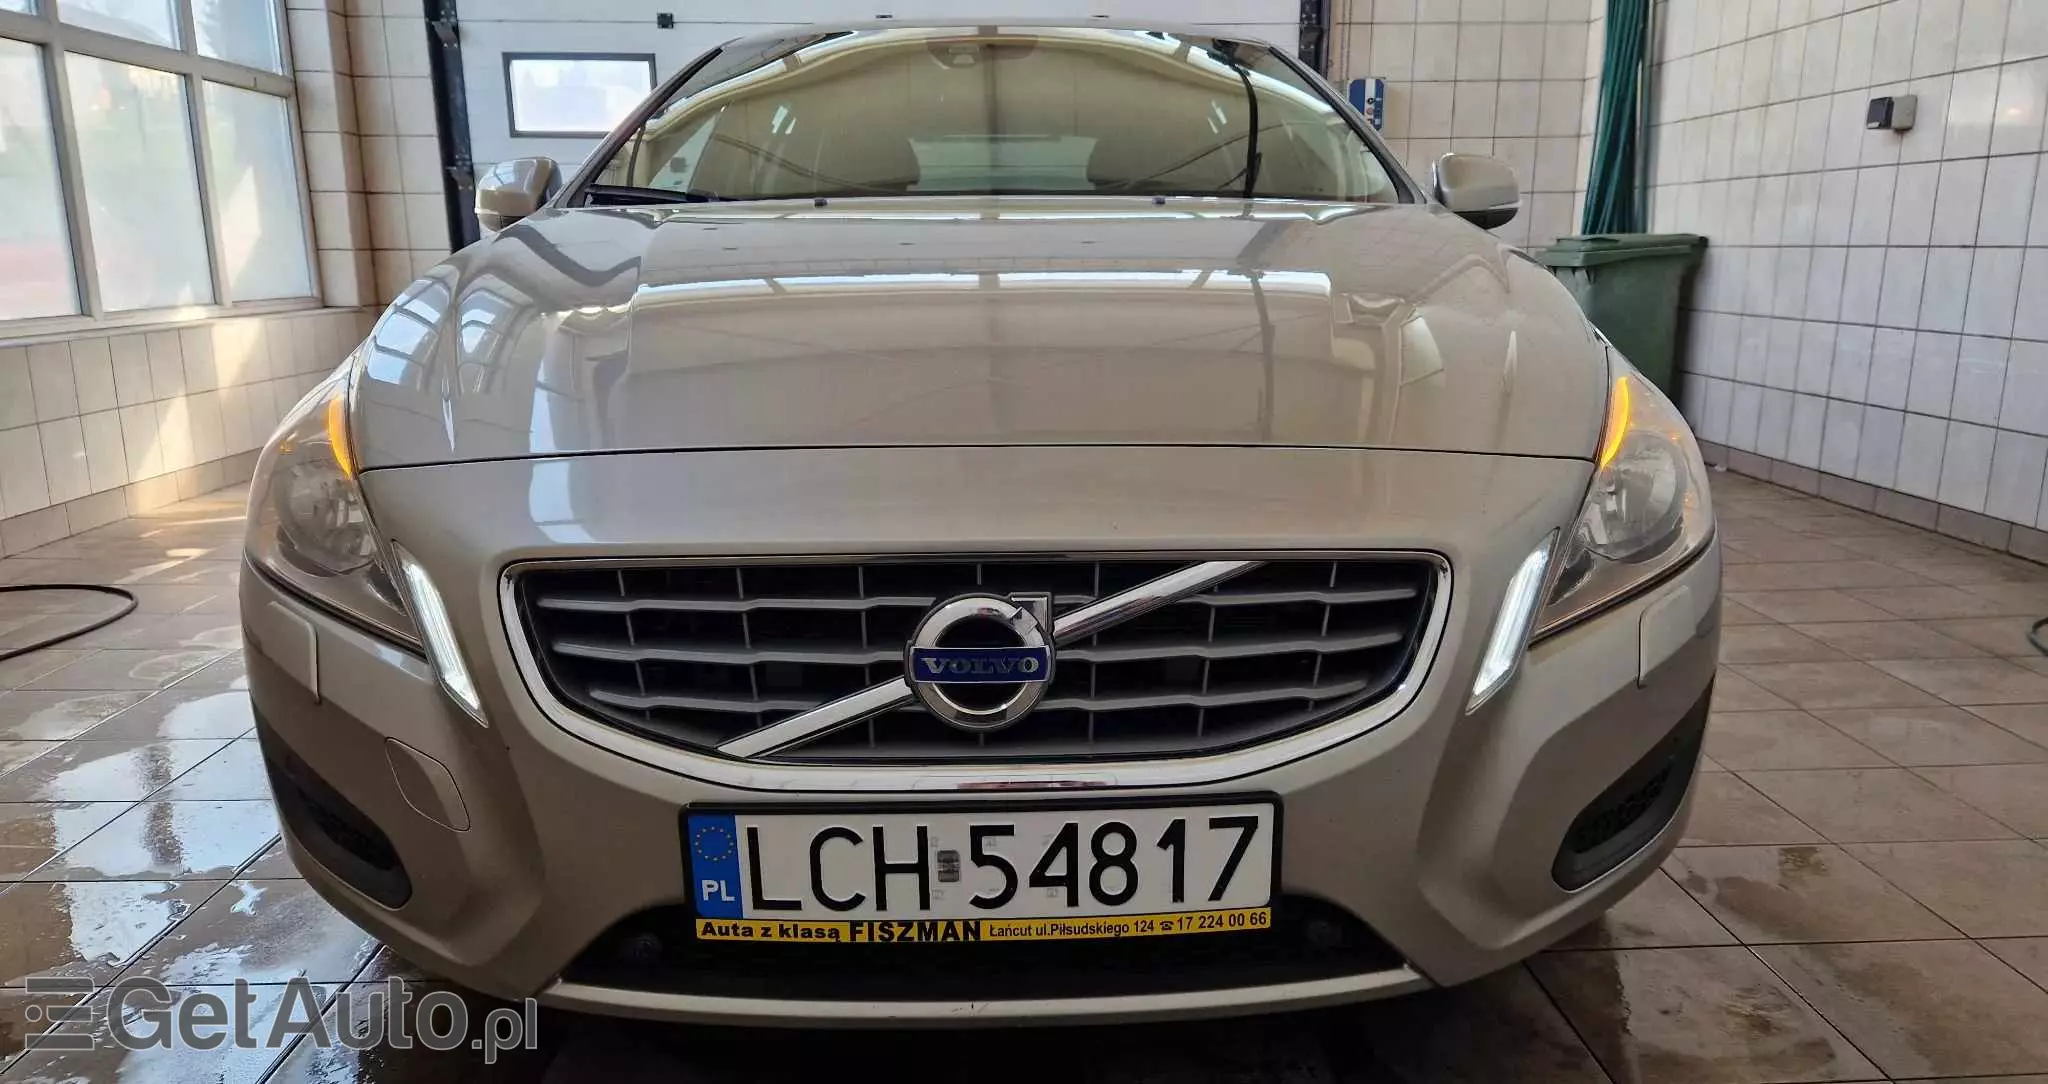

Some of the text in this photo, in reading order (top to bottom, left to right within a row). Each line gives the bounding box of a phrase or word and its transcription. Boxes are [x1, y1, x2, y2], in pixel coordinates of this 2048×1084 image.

[921, 657, 1039, 674] VOLVO
[746, 815, 1259, 912] LCH 54817
[701, 879, 735, 901] PL
[701, 921, 981, 942] Auta z klasą FISZMAN
[989, 924, 1032, 937] Łańcut
[1134, 920, 1154, 933] 124
[1177, 917, 1193, 931] 17
[1198, 915, 1223, 929] 224
[1228, 913, 1245, 927] 00
[1250, 912, 1267, 925] 66
